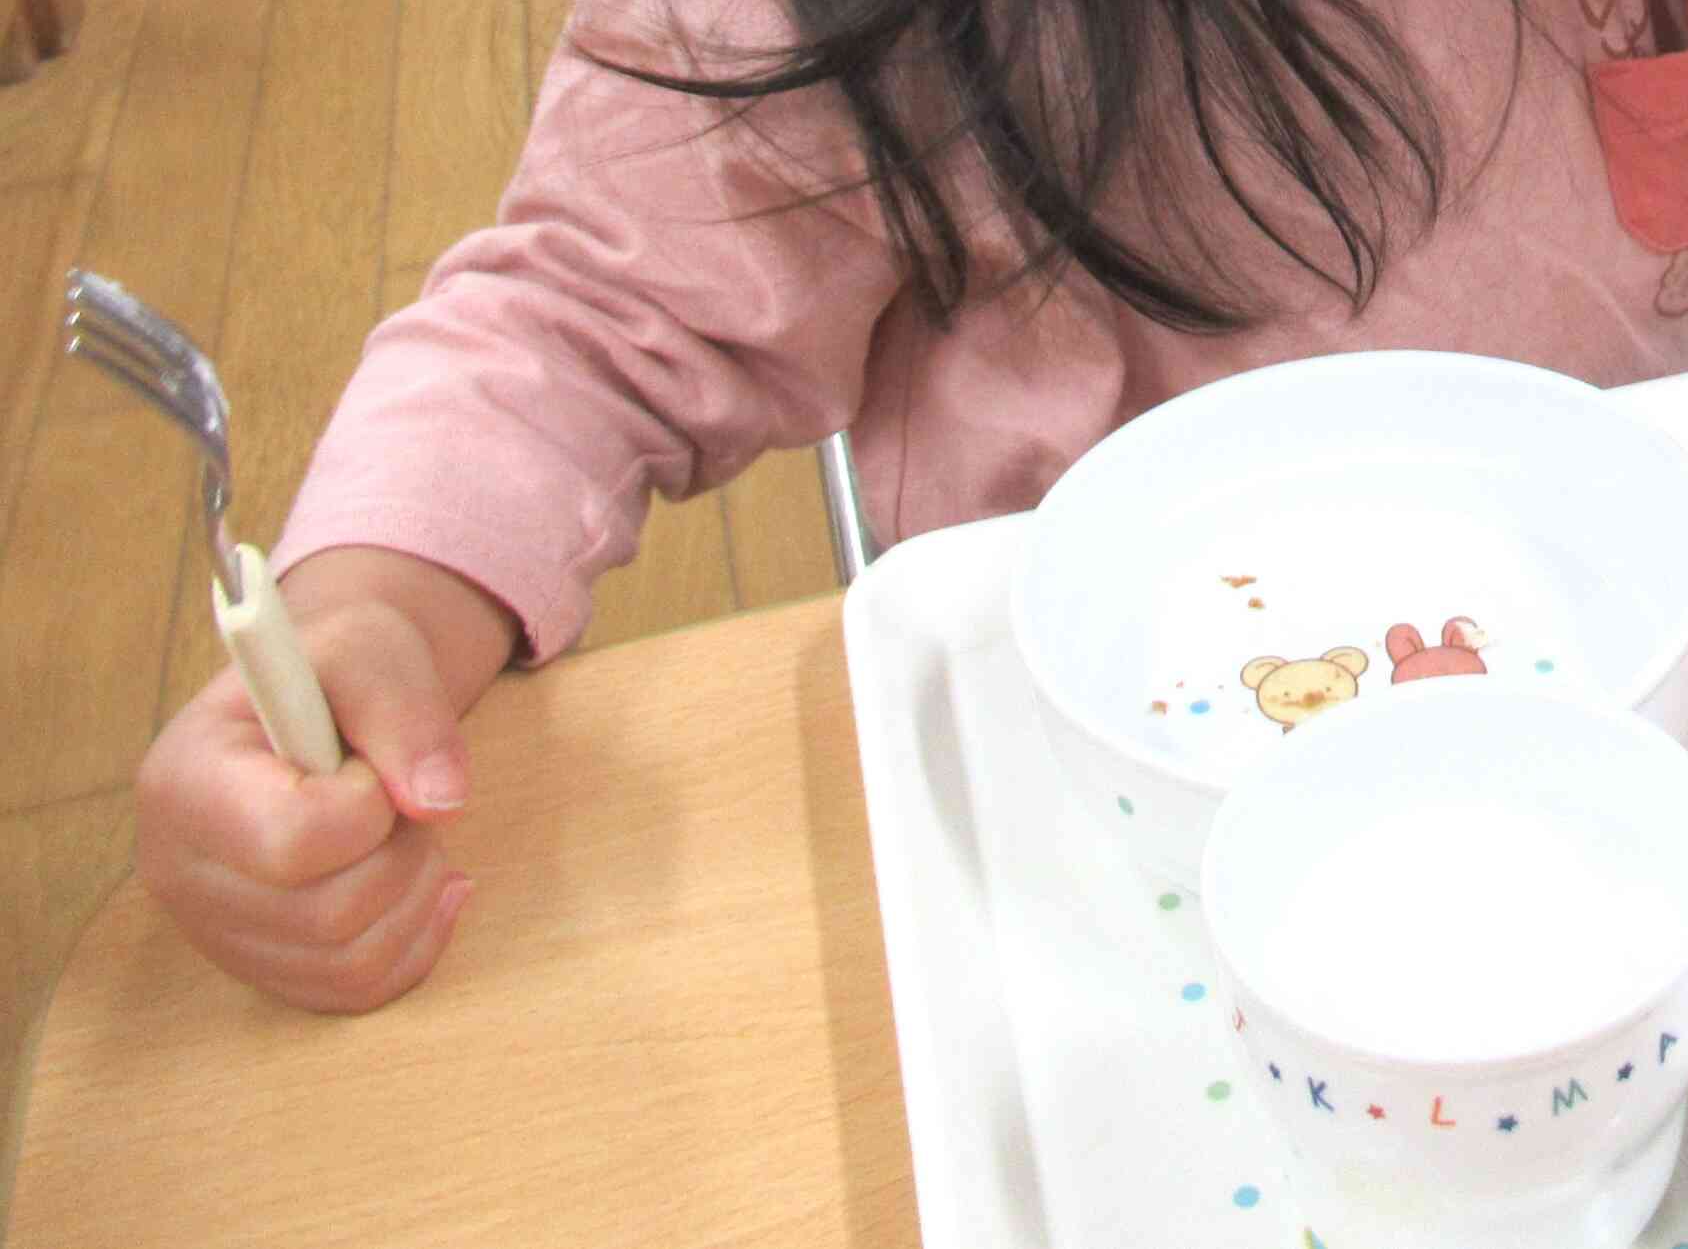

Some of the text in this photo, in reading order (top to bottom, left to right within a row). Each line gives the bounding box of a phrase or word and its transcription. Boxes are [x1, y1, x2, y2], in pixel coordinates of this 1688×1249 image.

[1306, 1076, 1335, 1113] K
[1430, 1096, 1457, 1128] L
[1552, 1078, 1589, 1116] M
